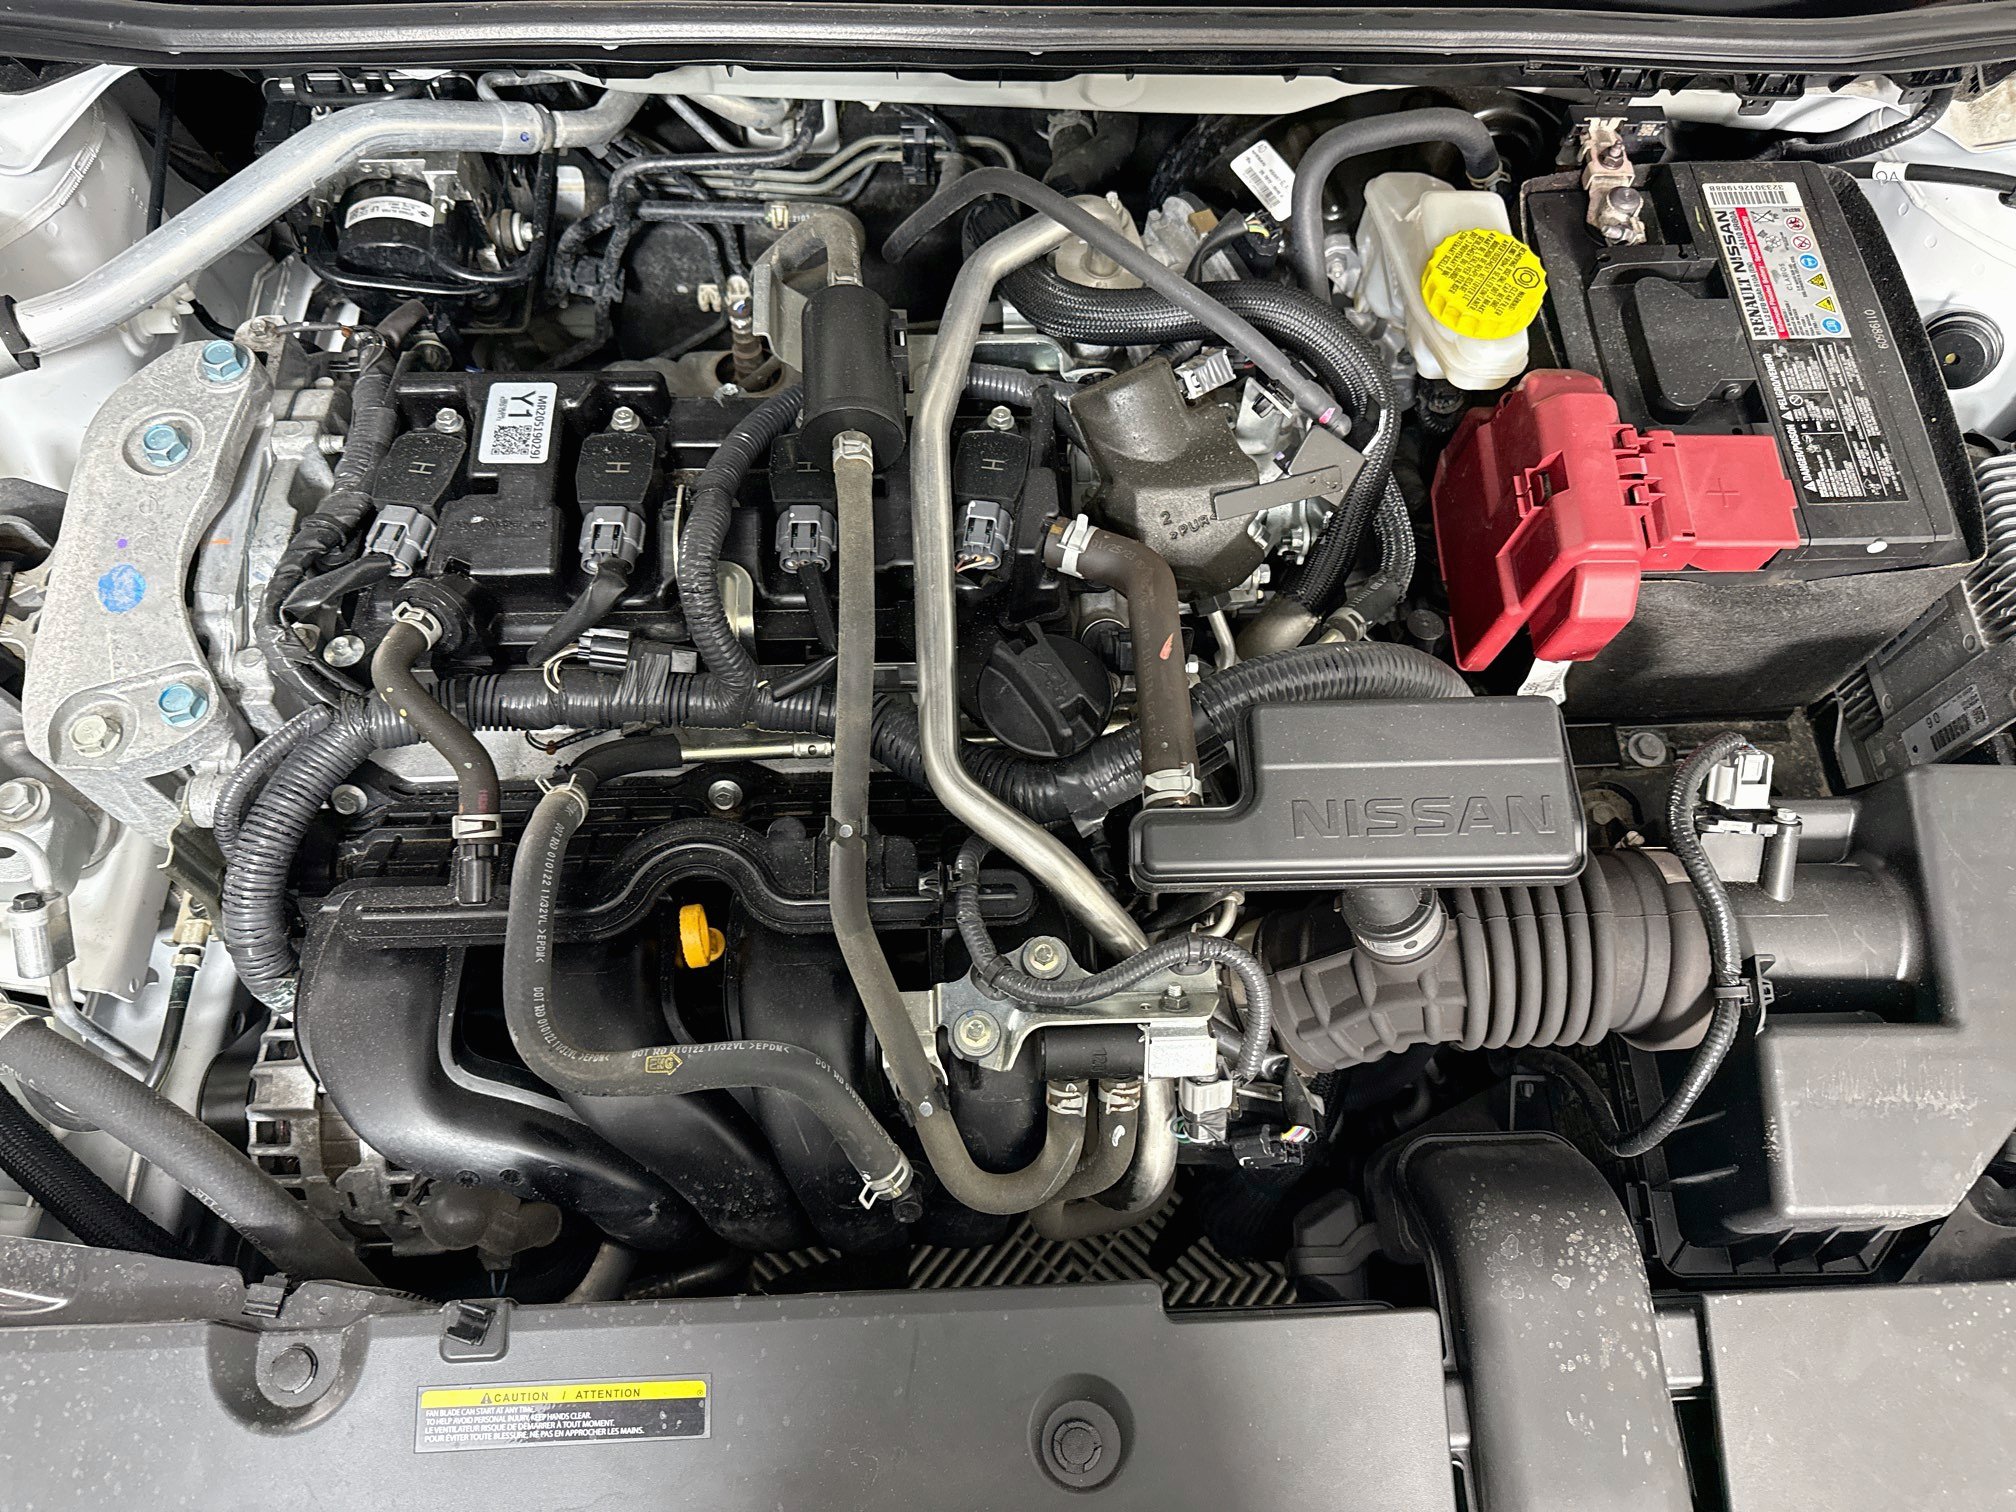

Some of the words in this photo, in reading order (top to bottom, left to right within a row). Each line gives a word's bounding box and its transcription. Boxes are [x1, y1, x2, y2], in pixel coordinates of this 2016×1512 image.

[1714, 210, 1746, 272] NISSAN
[1756, 265, 1769, 283] Battery
[1778, 262, 1793, 290] CLARIOS
[1762, 284, 1776, 305] Flooded
[1736, 277, 1768, 336] RENAULT
[1767, 325, 1776, 335] 12V
[1761, 353, 1790, 409] PELIGRO/VENENO
[508, 390, 536, 418] Y1
[530, 396, 548, 459] MR20519029J
[1784, 424, 1813, 481] DANGER/POISON
[1160, 510, 1172, 525] 2
[1291, 795, 1556, 838] NISSAN
[533, 987, 544, 1001] DOT
[749, 1043, 790, 1054] >EPDM<
[494, 1392, 548, 1403] CAUTION
[575, 1389, 641, 1399] ATTENTION
[434, 1425, 480, 1434] VENTILATEUR
[582, 1419, 615, 1427] MOMENT.
[565, 1428, 606, 1437] APPROCHER
